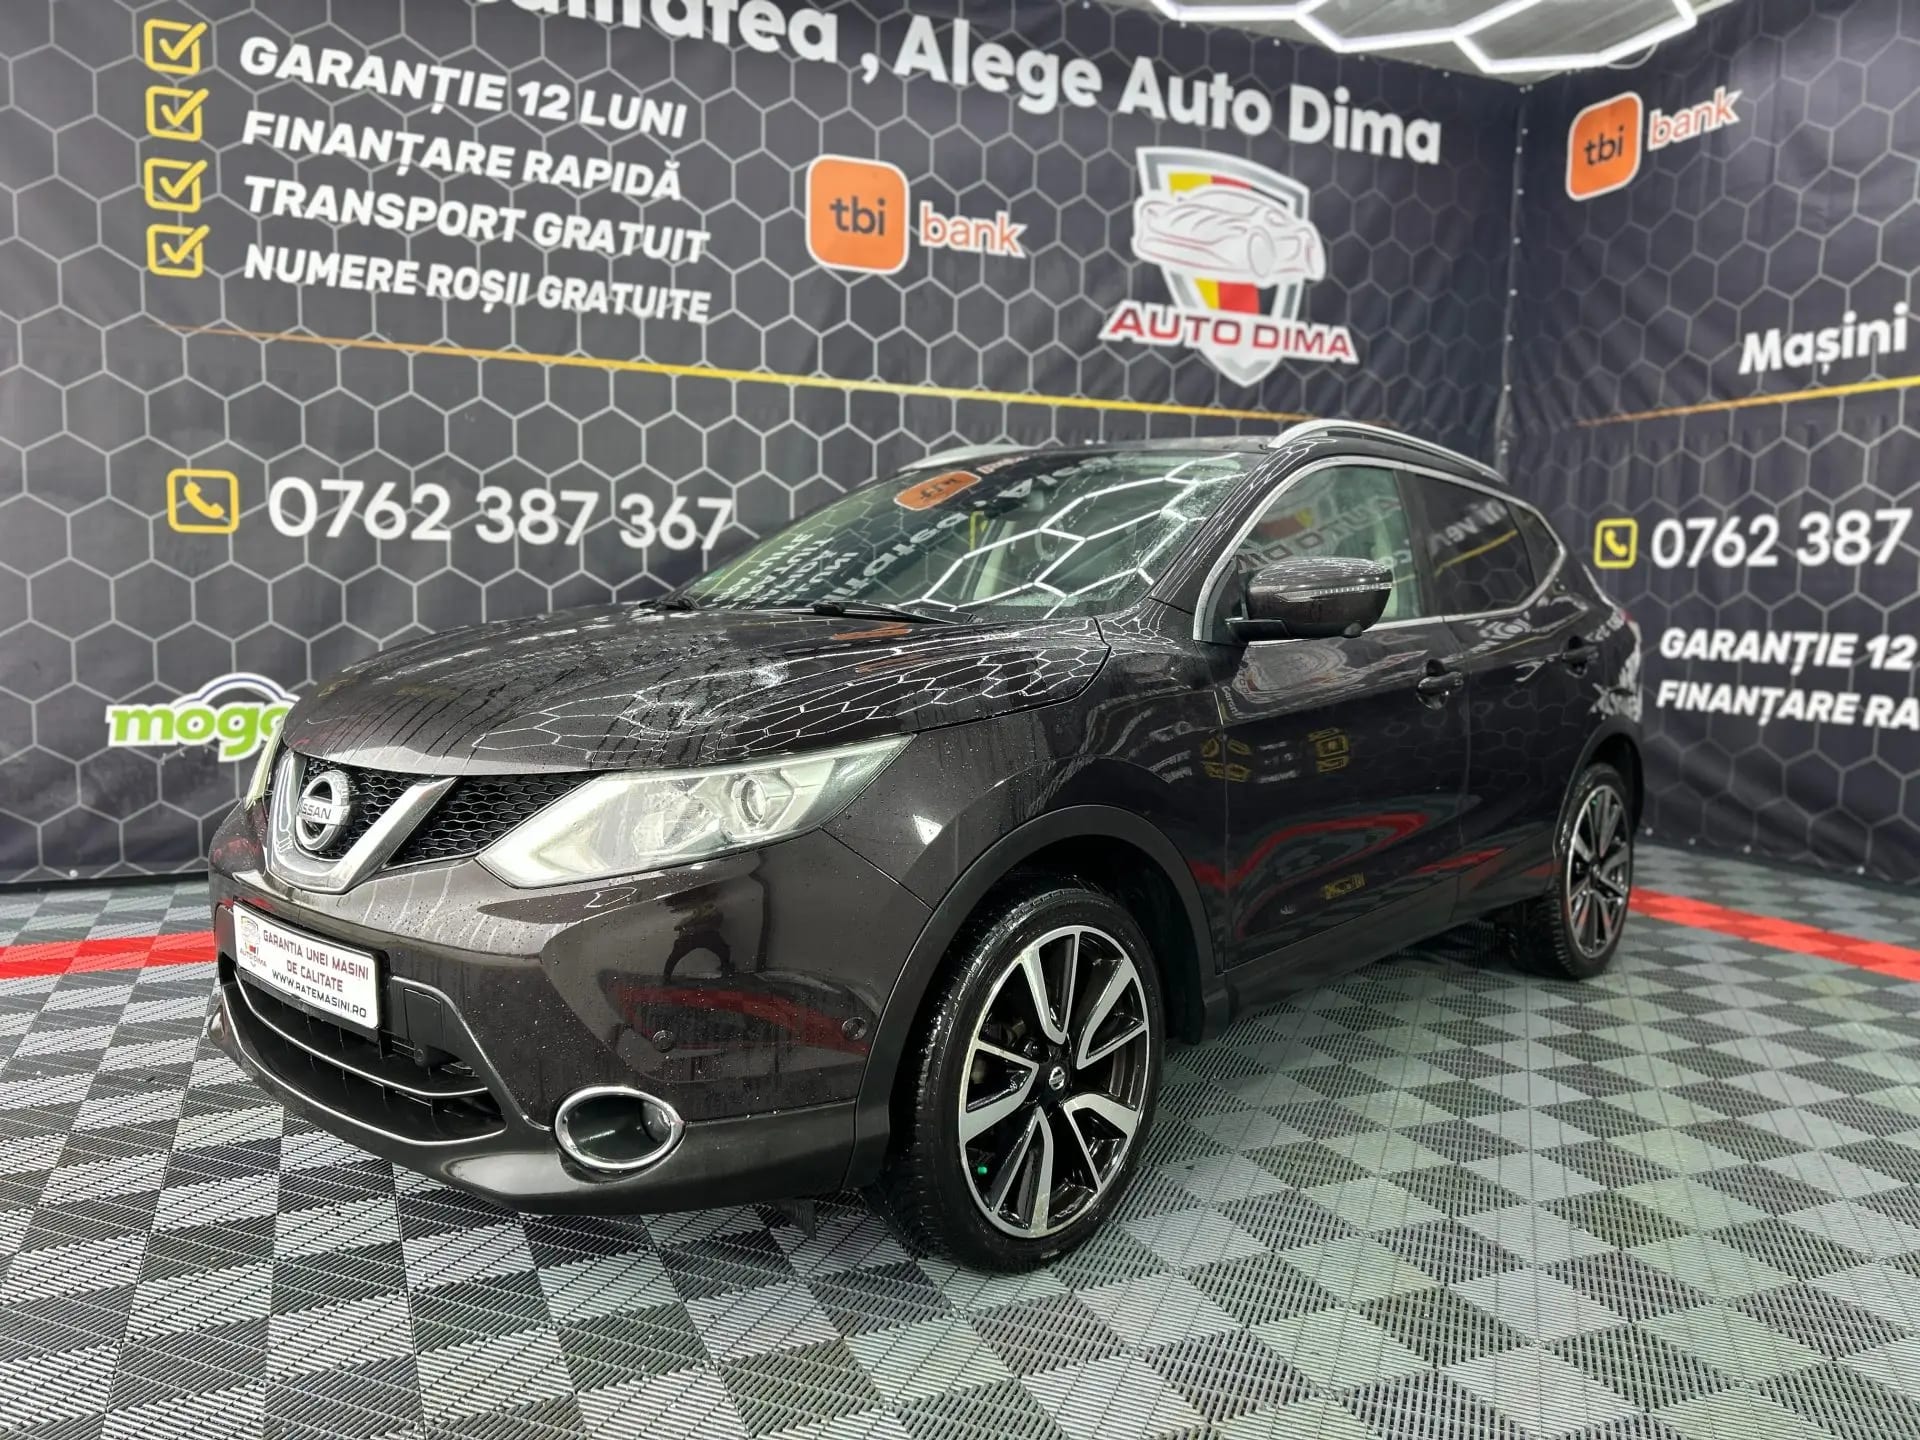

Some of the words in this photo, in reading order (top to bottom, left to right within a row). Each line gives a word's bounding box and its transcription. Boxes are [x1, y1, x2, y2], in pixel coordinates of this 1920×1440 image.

[239, 36, 507, 115] GARANȚIE
[517, 80, 570, 122] 12
[579, 90, 688, 138] LUNI
[893, 14, 1103, 114] Alege
[1117, 56, 1272, 137] Auto
[1289, 84, 1442, 164] Dima
[241, 111, 515, 177] FINANȚARE
[522, 151, 682, 200] RAPIDĂ
[1584, 126, 1624, 165] tbi
[1650, 88, 1739, 149] bank
[243, 175, 526, 243] TRANSPORT
[532, 212, 711, 264] GRATUIT
[830, 196, 886, 237] tbi
[920, 203, 1022, 256] bank
[244, 244, 419, 296] NUMERE
[425, 262, 529, 313] ROȘII
[536, 276, 711, 323] GRATUITE
[1109, 305, 1241, 346] AUTO
[1252, 323, 1352, 358] DIMA
[1738, 301, 1909, 375] Mașini
[268, 476, 452, 543] 0762
[474, 486, 600, 546] 387
[619, 492, 734, 551] 367
[1651, 514, 1780, 568] 0762
[1796, 508, 1913, 567] 387
[1659, 627, 1858, 676] GARANȚIE
[1865, 634, 1918, 670] 12
[1656, 680, 1860, 726] FINANȚARE
[301, 803, 331, 819] SSAN
[262, 929, 303, 959] GARANTIA
[306, 947, 329, 967] UNEI
[332, 955, 369, 980] MASINI
[286, 959, 298, 975] DE
[300, 966, 344, 993] CALITATE
[271, 968, 367, 1018] WWW.RATEMASINI.RO
